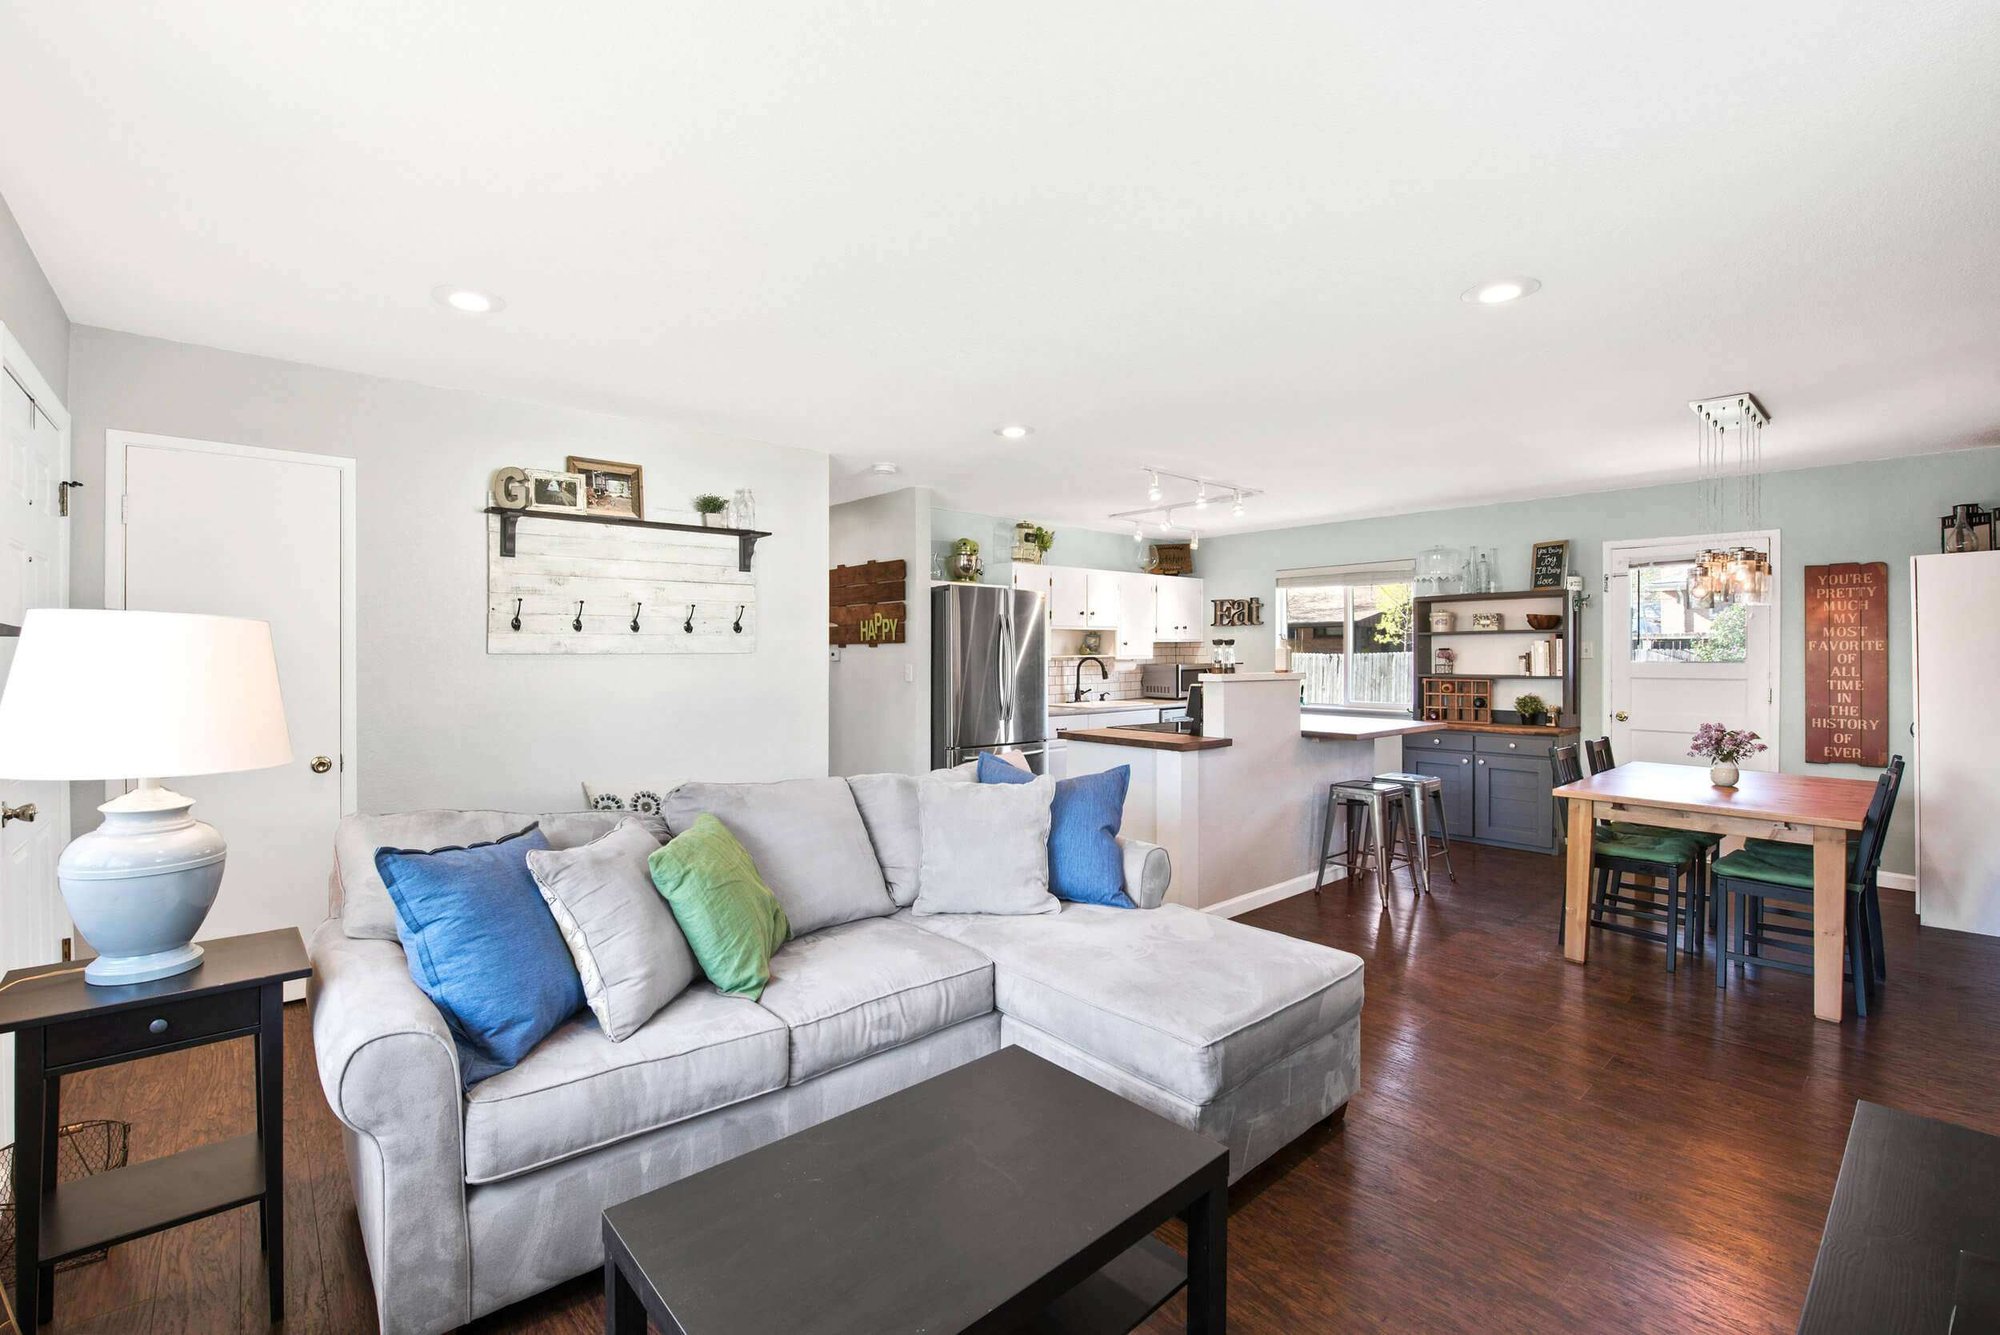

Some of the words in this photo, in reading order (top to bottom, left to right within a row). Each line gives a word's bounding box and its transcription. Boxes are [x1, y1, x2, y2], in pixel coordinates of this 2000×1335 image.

[495, 466, 530, 509] G
[1818, 572, 1873, 586] YOU'RE
[1816, 586, 1877, 599] PRETTY
[1823, 600, 1869, 611] MUCH
[1210, 597, 1264, 627] Eat
[1833, 613, 1858, 624] MY
[860, 612, 898, 642] HAPPY
[1823, 626, 1868, 637] MOST
[1808, 640, 1885, 651] FAVORITE
[1837, 653, 1857, 664] OF
[1830, 666, 1860, 677] ALL
[1827, 680, 1865, 691] TIME
[1837, 692, 1852, 703] IN
[1830, 705, 1859, 717] THE
[1812, 718, 1879, 730] HISTORY
[1833, 733, 1853, 744] OF
